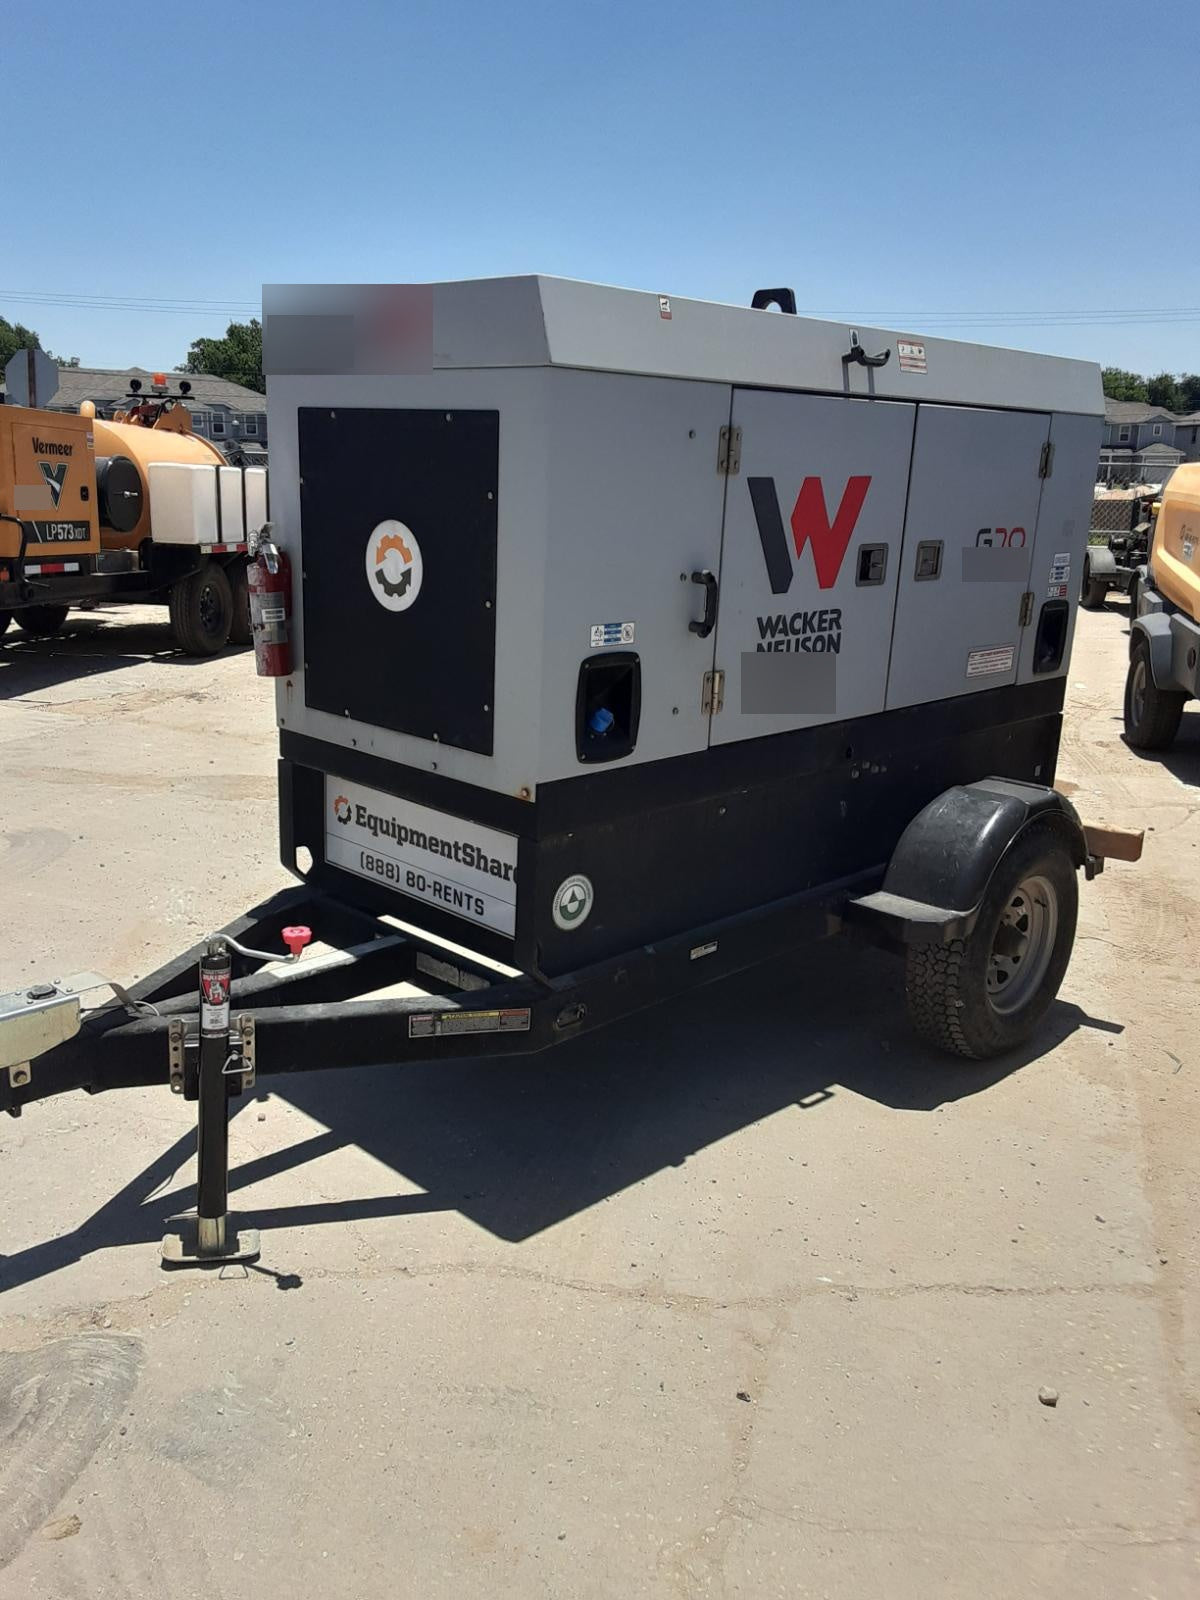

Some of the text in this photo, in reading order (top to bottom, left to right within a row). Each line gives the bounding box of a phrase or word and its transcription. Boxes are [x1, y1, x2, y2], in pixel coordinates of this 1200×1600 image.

[32, 437, 73, 456] Vermeer
[757, 608, 842, 639] WACKER
[360, 851, 485, 916] (888) 80-RENTS
